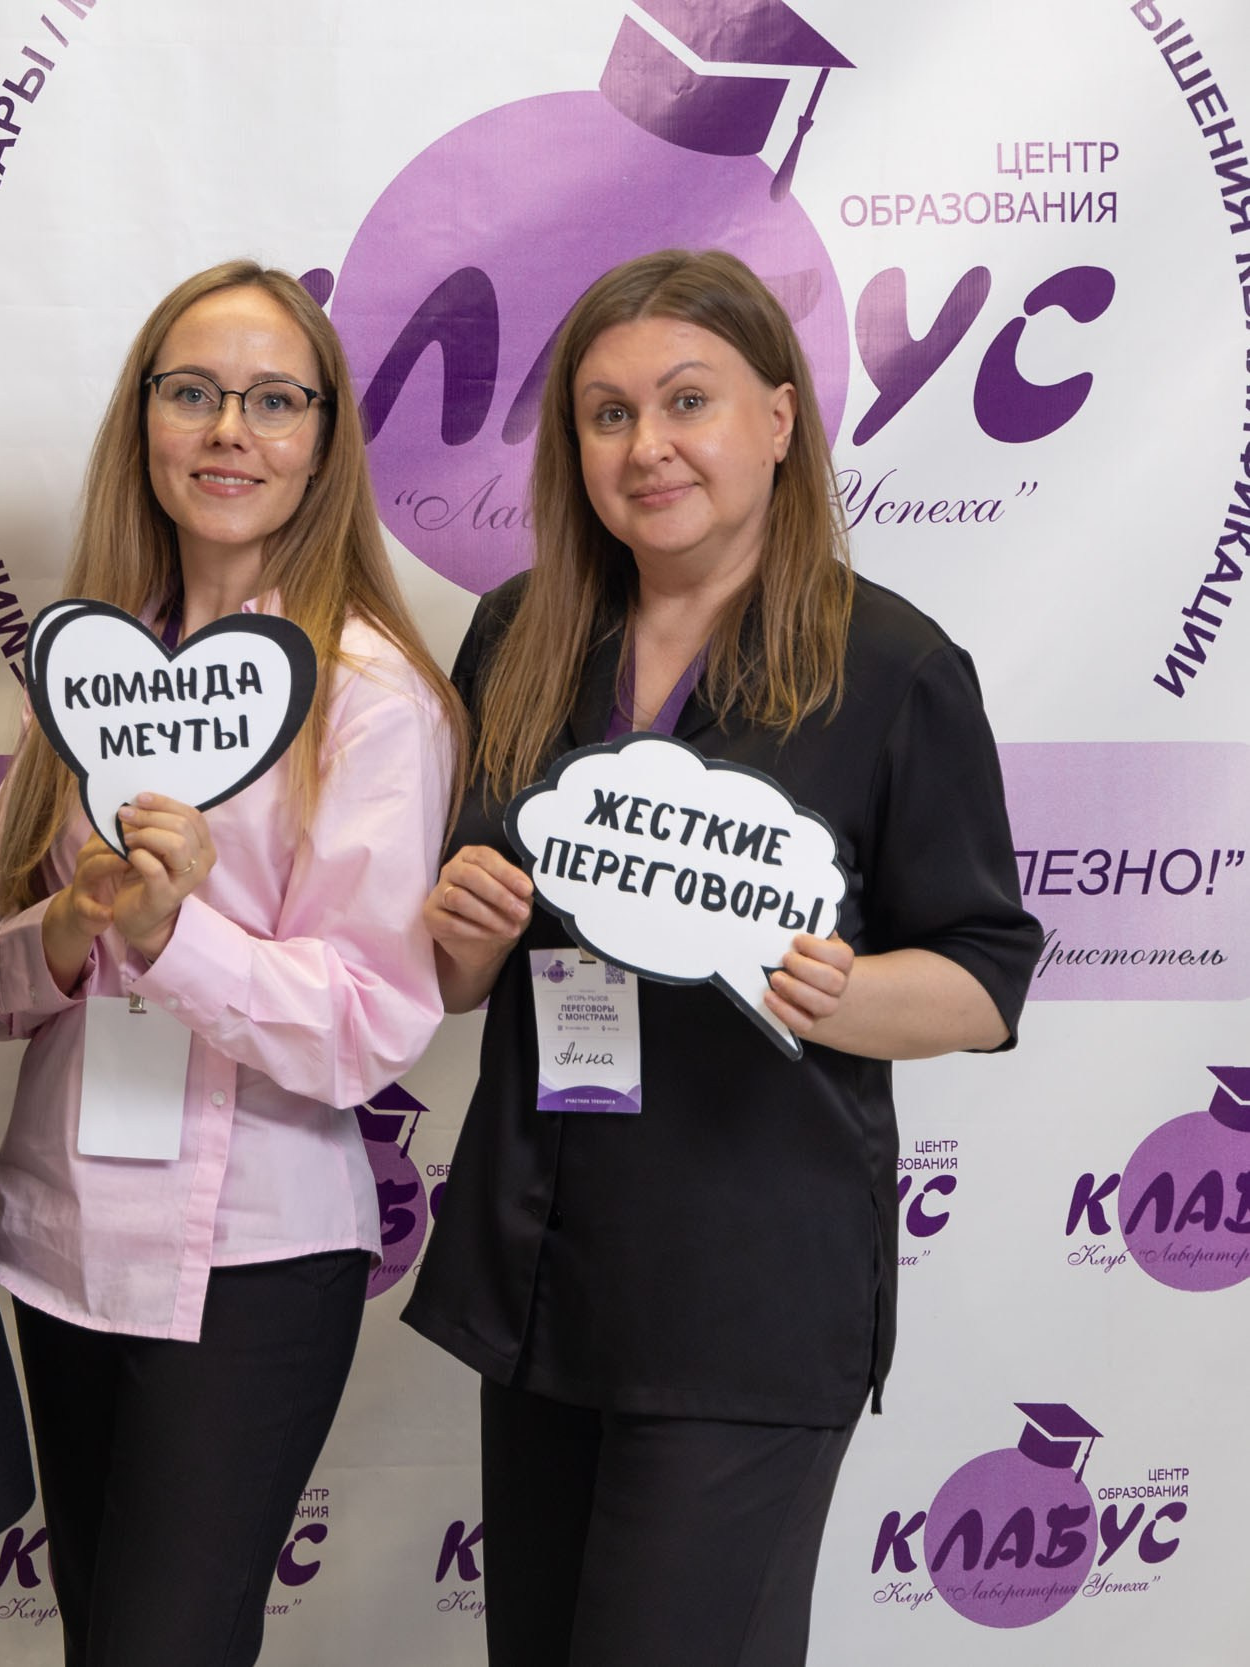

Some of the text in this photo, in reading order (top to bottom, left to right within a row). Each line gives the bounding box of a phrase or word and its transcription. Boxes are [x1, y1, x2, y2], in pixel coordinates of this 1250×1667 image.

[996, 141, 1119, 180] ЦЕНТР
[840, 190, 1118, 227] ОБРАЗОВАНИЯ
[64, 661, 263, 710] КОМАНДА
[99, 714, 250, 760] МЕЧТЫ
[583, 788, 791, 867] ЖЕСТКИЕ
[539, 836, 824, 935] ПЕРЕГОВОРЫ
[558, 1013, 619, 1022] С МОНСТРАМИ
[561, 1004, 615, 1013] ПЕРЕГОВОРЫ
[554, 1041, 615, 1066] Анна
[915, 1140, 958, 1154] ЦЕНТР
[1067, 1244, 1131, 1274] Клуб
[1148, 1467, 1190, 1482] ЦЕНТР
[1098, 1484, 1189, 1500] ОБРАЗОВАНИЯ
[871, 1501, 1187, 1574] КЛАБУС
[873, 1582, 939, 1611] Клуб
